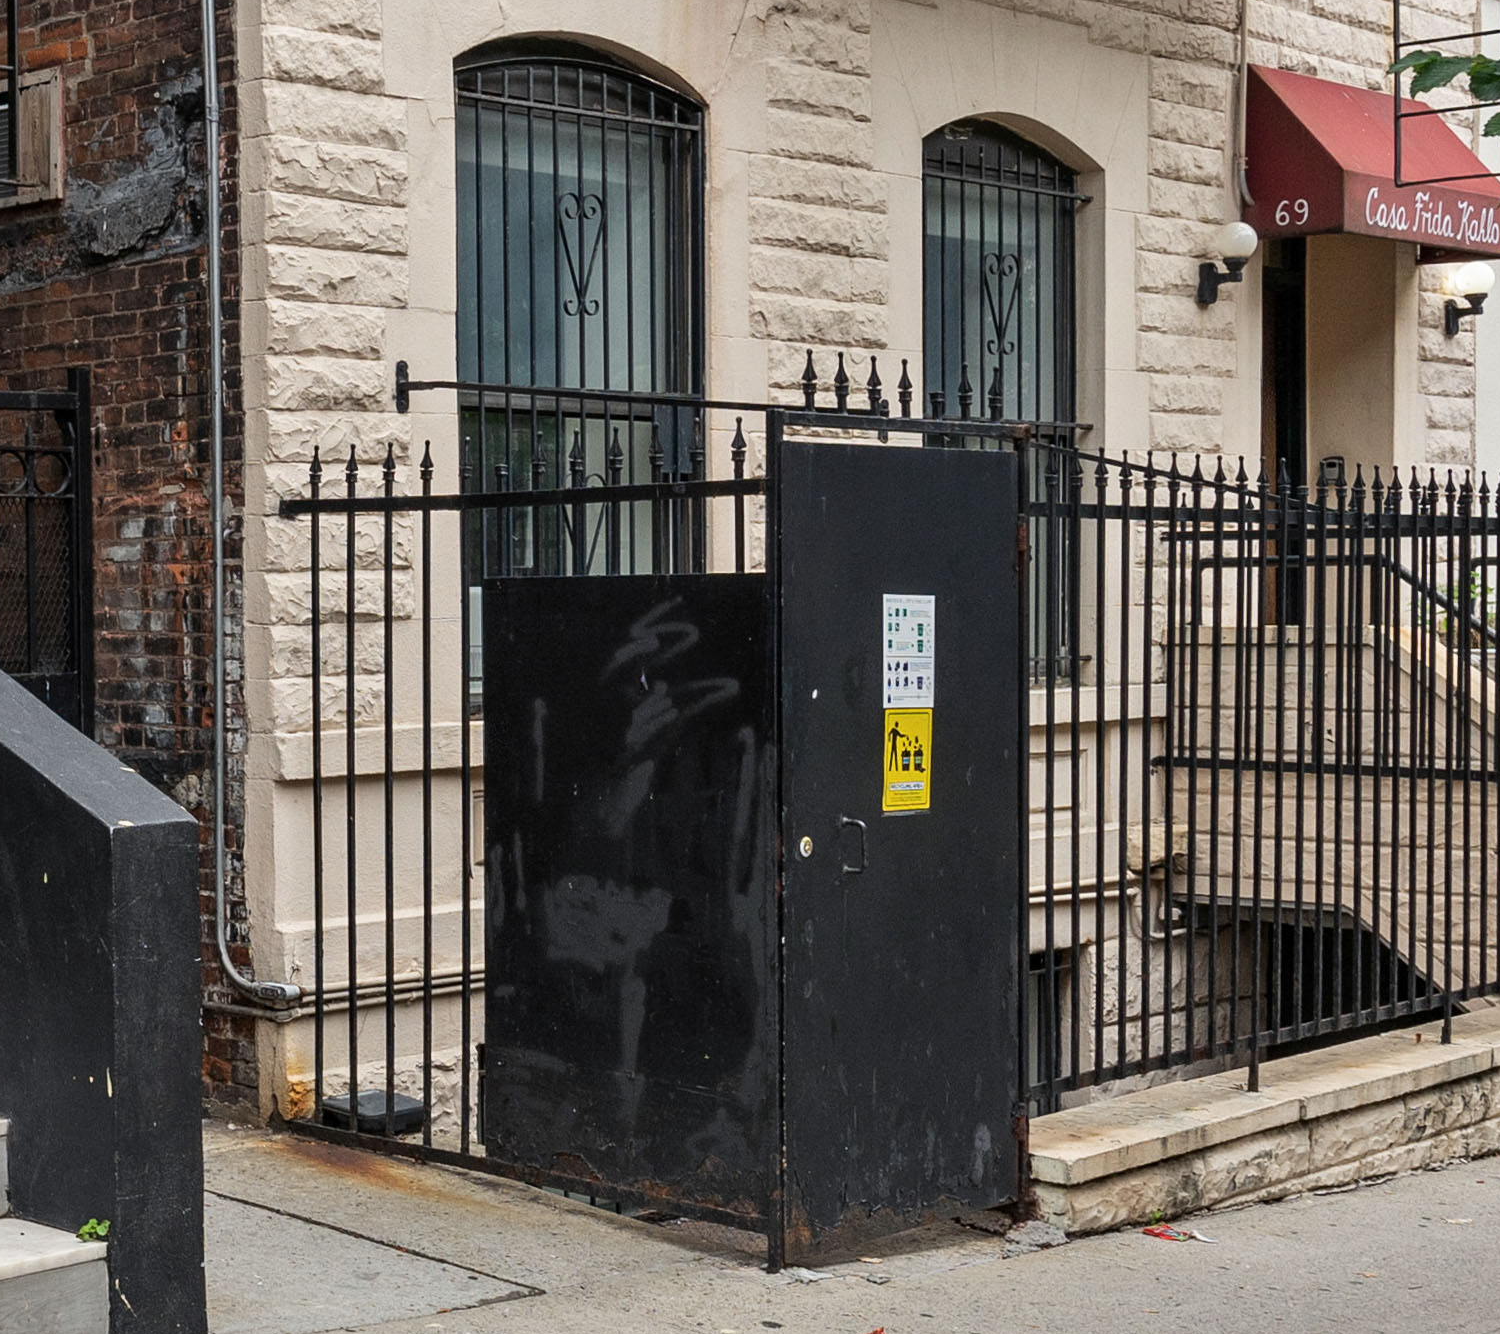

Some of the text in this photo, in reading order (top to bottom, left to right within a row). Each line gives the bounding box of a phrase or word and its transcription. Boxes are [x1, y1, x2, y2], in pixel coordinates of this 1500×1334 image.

[1275, 199, 1309, 225] 69
[1365, 187, 1500, 245] Casa Frida Kahlo
